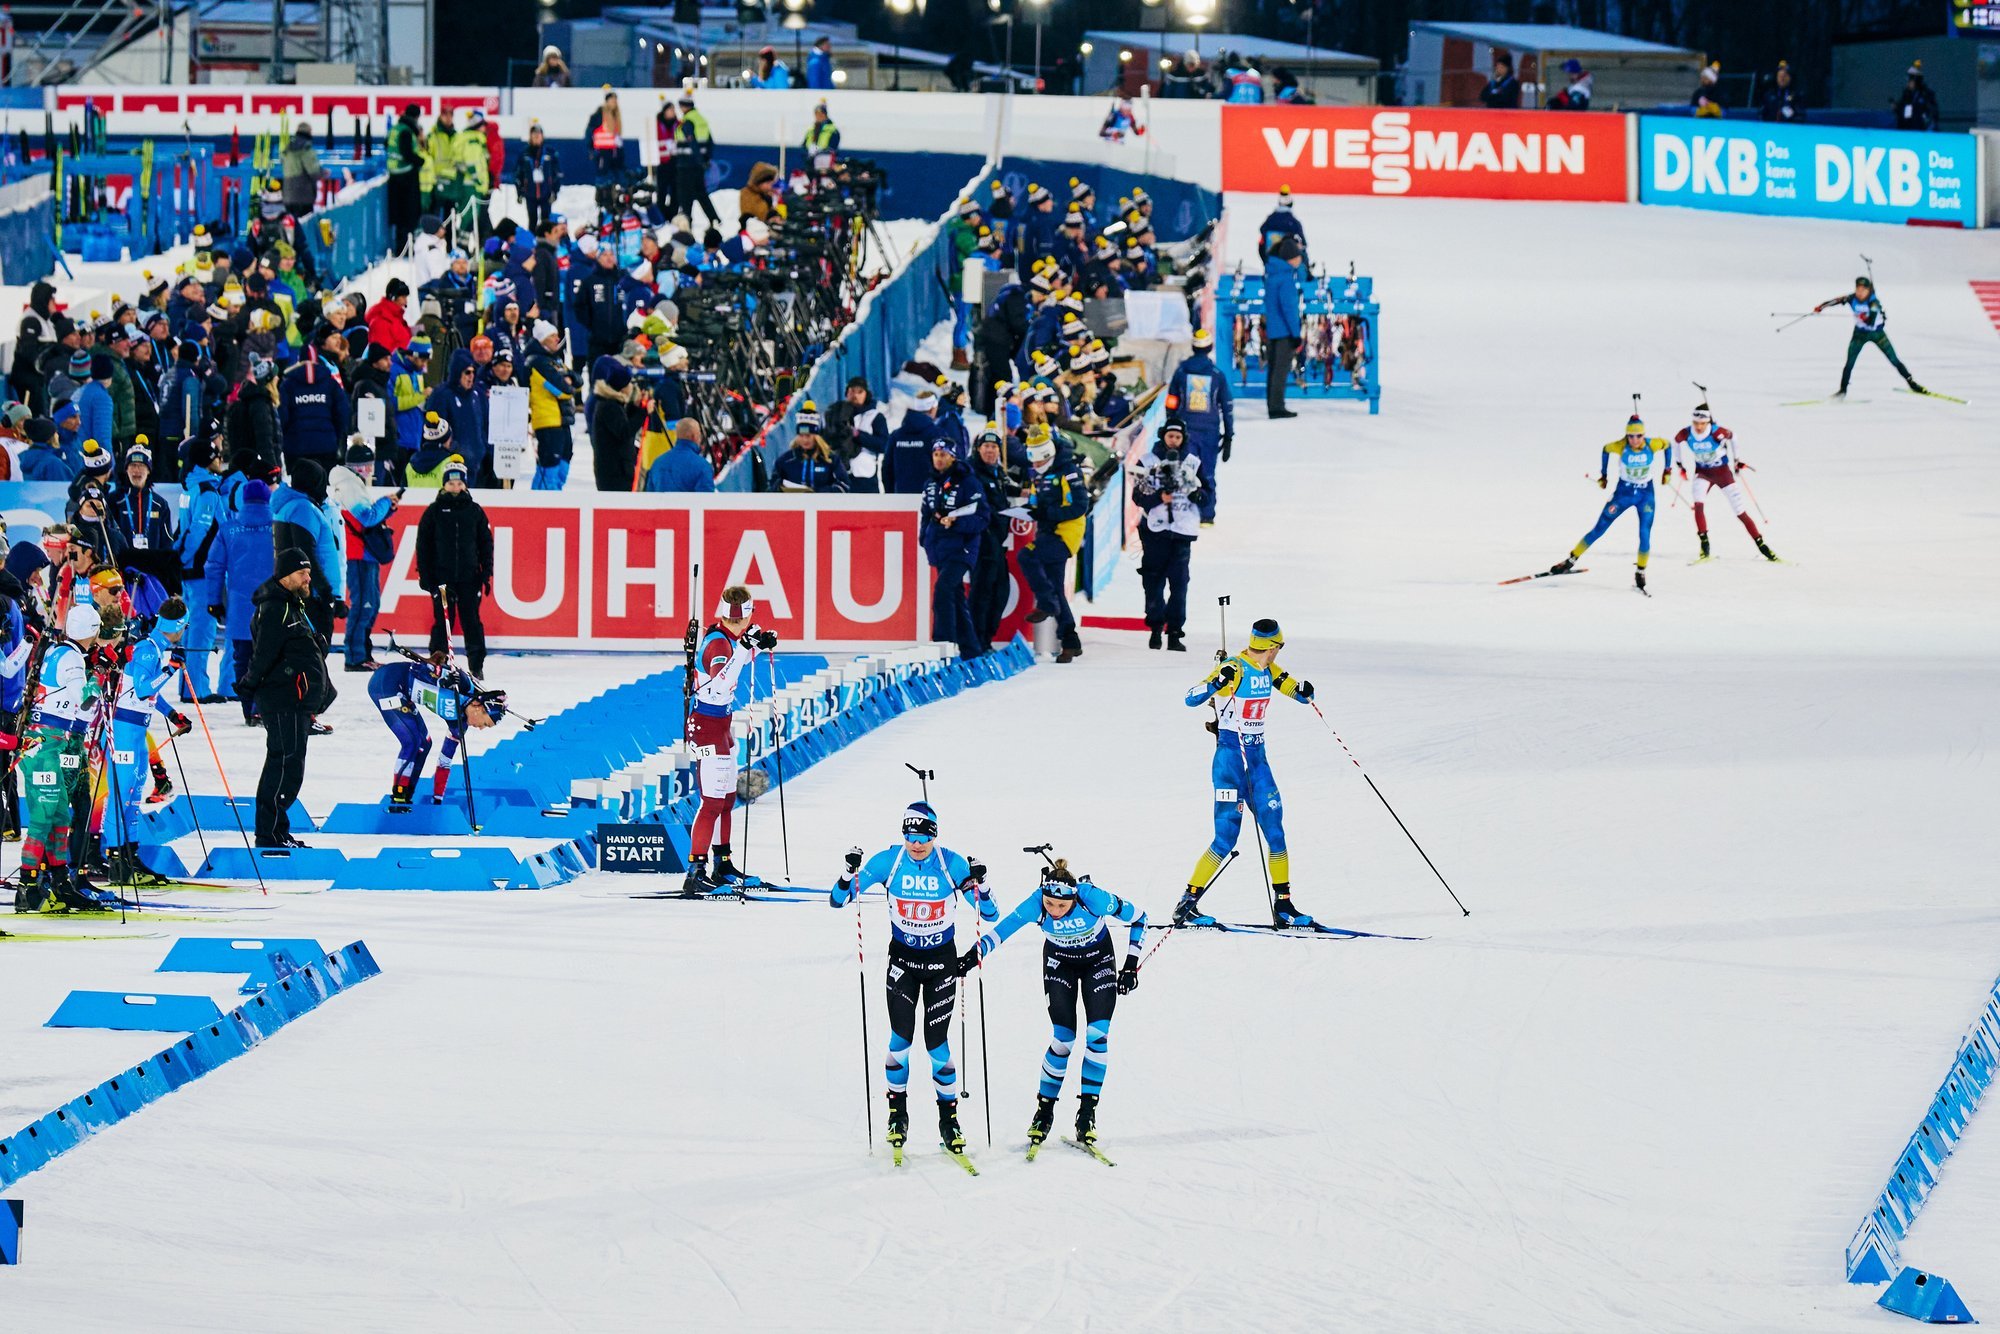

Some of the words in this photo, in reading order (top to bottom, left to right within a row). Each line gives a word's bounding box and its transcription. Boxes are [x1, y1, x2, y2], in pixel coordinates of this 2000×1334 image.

[1261, 112, 1585, 194] VIESSMANN
[1765, 141, 1789, 159] Das
[1653, 133, 1760, 196] DKB
[1928, 151, 1954, 169] Das
[1765, 162, 1796, 179] kann
[1814, 143, 1923, 206] DKB
[1928, 171, 1961, 190] kann
[1765, 181, 1796, 199] Bank
[1928, 191, 1961, 209] Bank
[295, 394, 326, 404] NORGE
[1250, 675, 1270, 689] DKB
[55, 700, 70, 709] 18
[444, 698, 455, 718] DKB
[801, 698, 814, 727] 4
[118, 753, 128, 762] 14
[700, 748, 710, 757] 15
[63, 756, 75, 767] 20
[40, 774, 52, 783] 18
[1220, 791, 1230, 800] 11
[905, 818, 924, 826] LHV
[606, 836, 634, 844] HAND
[637, 836, 664, 844] OVER
[606, 846, 665, 862] START
[901, 874, 939, 891] DKB
[903, 903, 932, 920] 10
[1052, 917, 1086, 930] DKB
[920, 933, 943, 948] iX3
